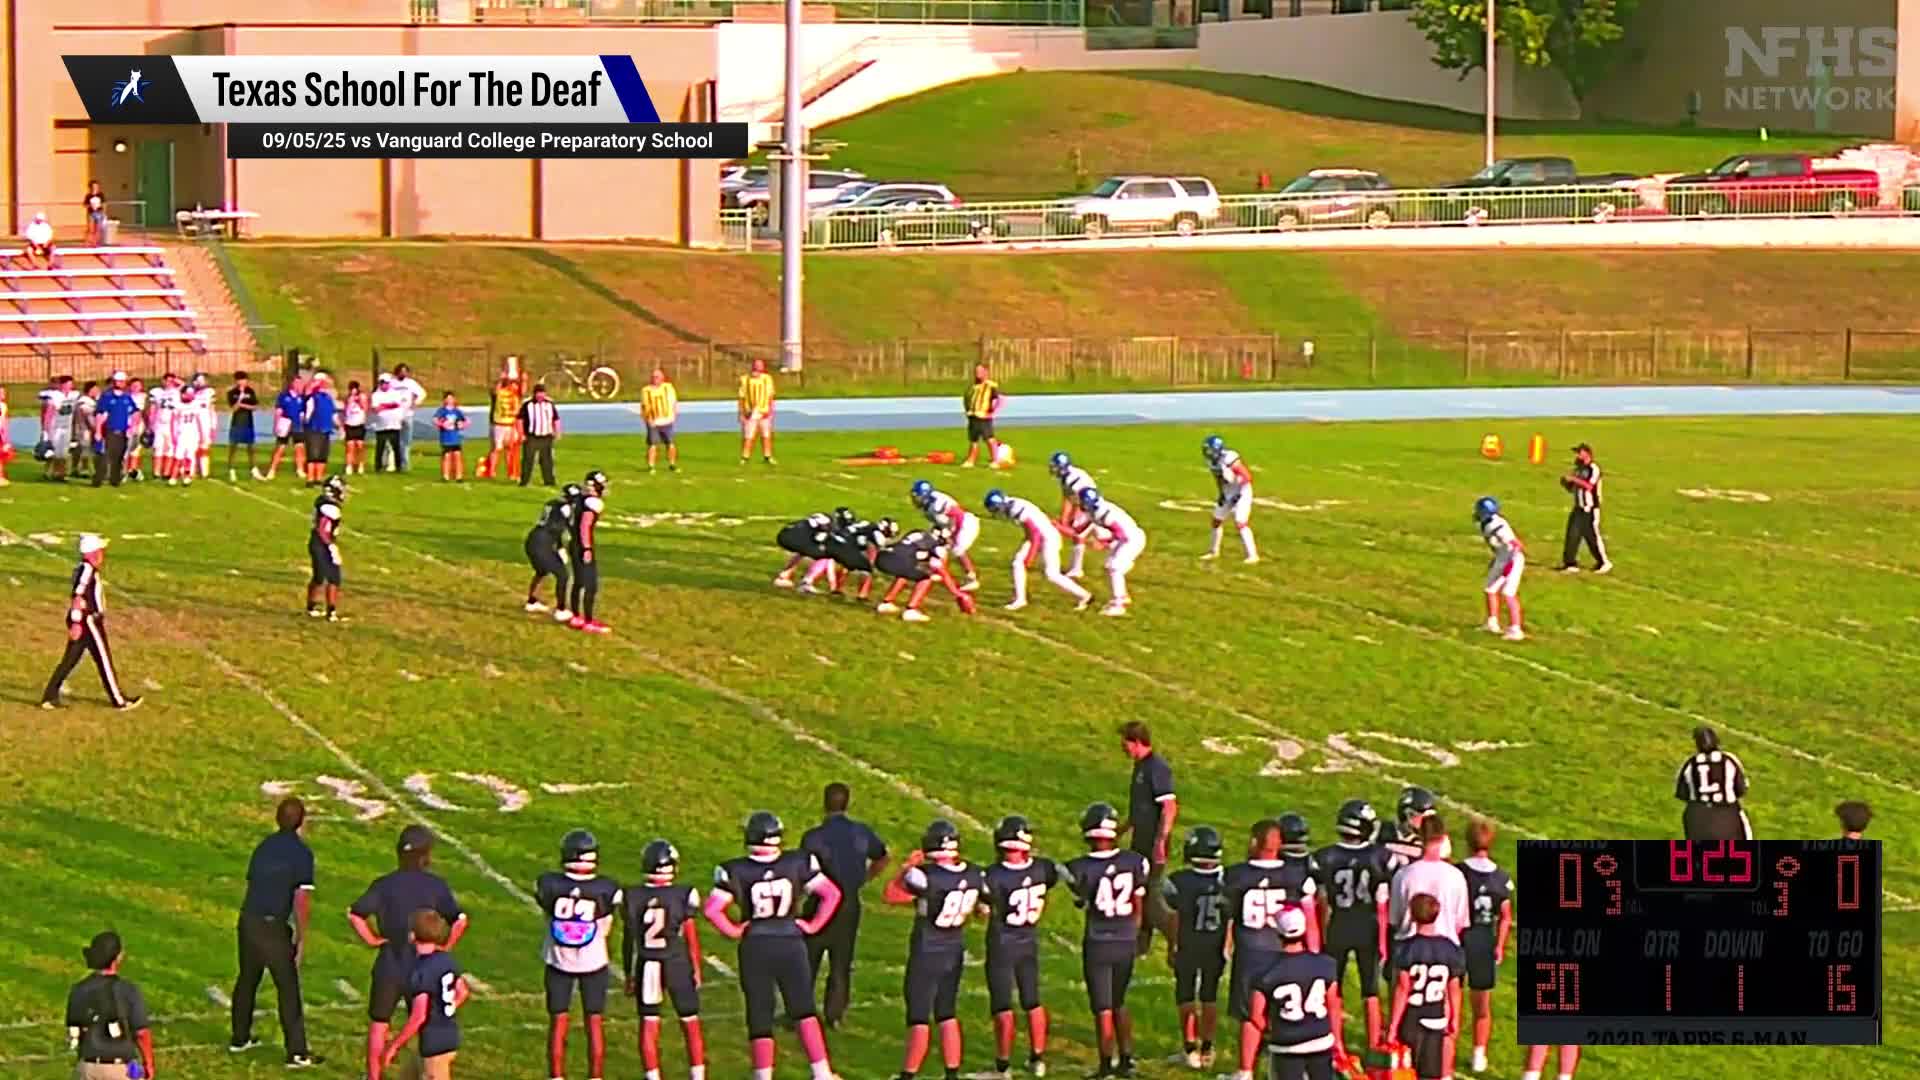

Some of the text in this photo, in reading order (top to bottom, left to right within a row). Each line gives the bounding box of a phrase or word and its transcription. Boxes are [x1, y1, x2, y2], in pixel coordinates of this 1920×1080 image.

[1697, 764, 1720, 793] L
[751, 878, 793, 918] 67
[1006, 883, 1047, 926] 35
[1095, 872, 1134, 917] 42
[1334, 868, 1373, 908] 34
[1606, 880, 1621, 915] 3
[1773, 881, 1789, 916] 3
[643, 908, 667, 948] 2
[1195, 894, 1222, 931] 15
[1242, 888, 1287, 929] 65
[1519, 928, 1601, 958] BALL ON
[1644, 930, 1681, 958] QTR
[1703, 930, 1764, 959] DOWN
[1808, 931, 1863, 957] TO GO
[1273, 978, 1328, 1021] 34
[1536, 963, 1579, 1011] 20
[1665, 964, 1672, 1011] 1
[1738, 965, 1744, 1011] 1
[1828, 965, 1856, 1011] 15
